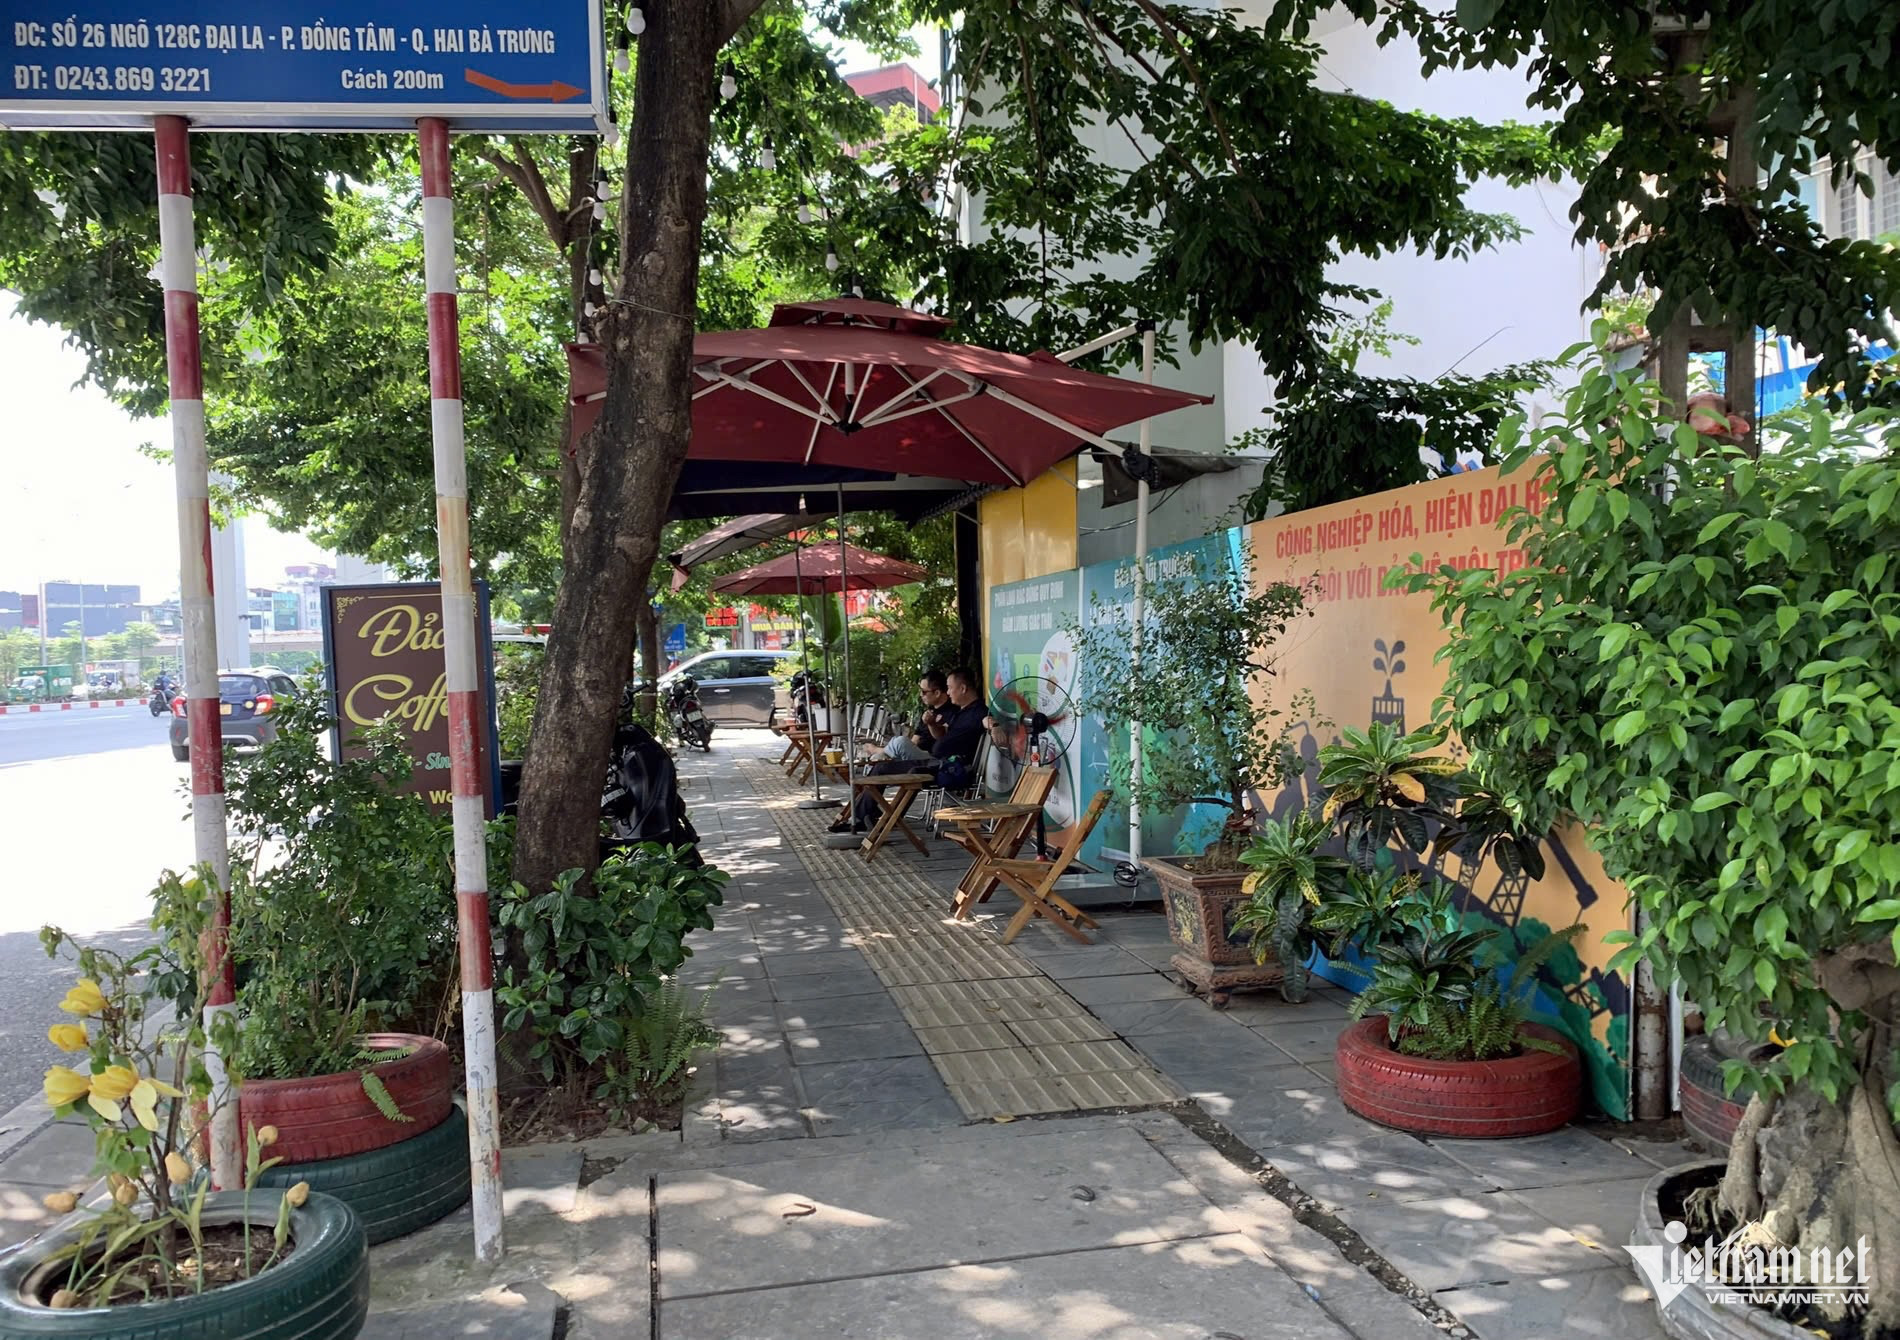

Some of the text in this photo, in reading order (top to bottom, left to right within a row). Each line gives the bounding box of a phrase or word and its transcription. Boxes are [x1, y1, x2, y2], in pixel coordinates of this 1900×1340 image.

[15, 22, 46, 47] ĐC:
[52, 14, 77, 47] SỐ
[82, 24, 105, 47] 26
[111, 18, 149, 48] NGÕ
[155, 24, 200, 48] 128C
[206, 25, 237, 53] ĐẠI
[242, 26, 264, 49] LA
[281, 26, 295, 50] P.
[301, 17, 351, 50] ĐỒNG
[355, 22, 396, 51] TÂM
[412, 28, 429, 54] Q.
[434, 29, 464, 52] HAI
[469, 25, 494, 53] BÀ
[497, 28, 555, 53] TRƯNG
[15, 65, 210, 92] ĐT: 0243.869 3221
[341, 68, 444, 89] Cách 200m
[1276, 524, 1312, 559] CÔNG
[1317, 508, 1373, 553] NGHIỆP
[1378, 499, 1419, 541] HÓA,
[1425, 488, 1472, 538] HIỆN
[1347, 561, 1372, 600] VỚI
[425, 751, 452, 771] Sin
